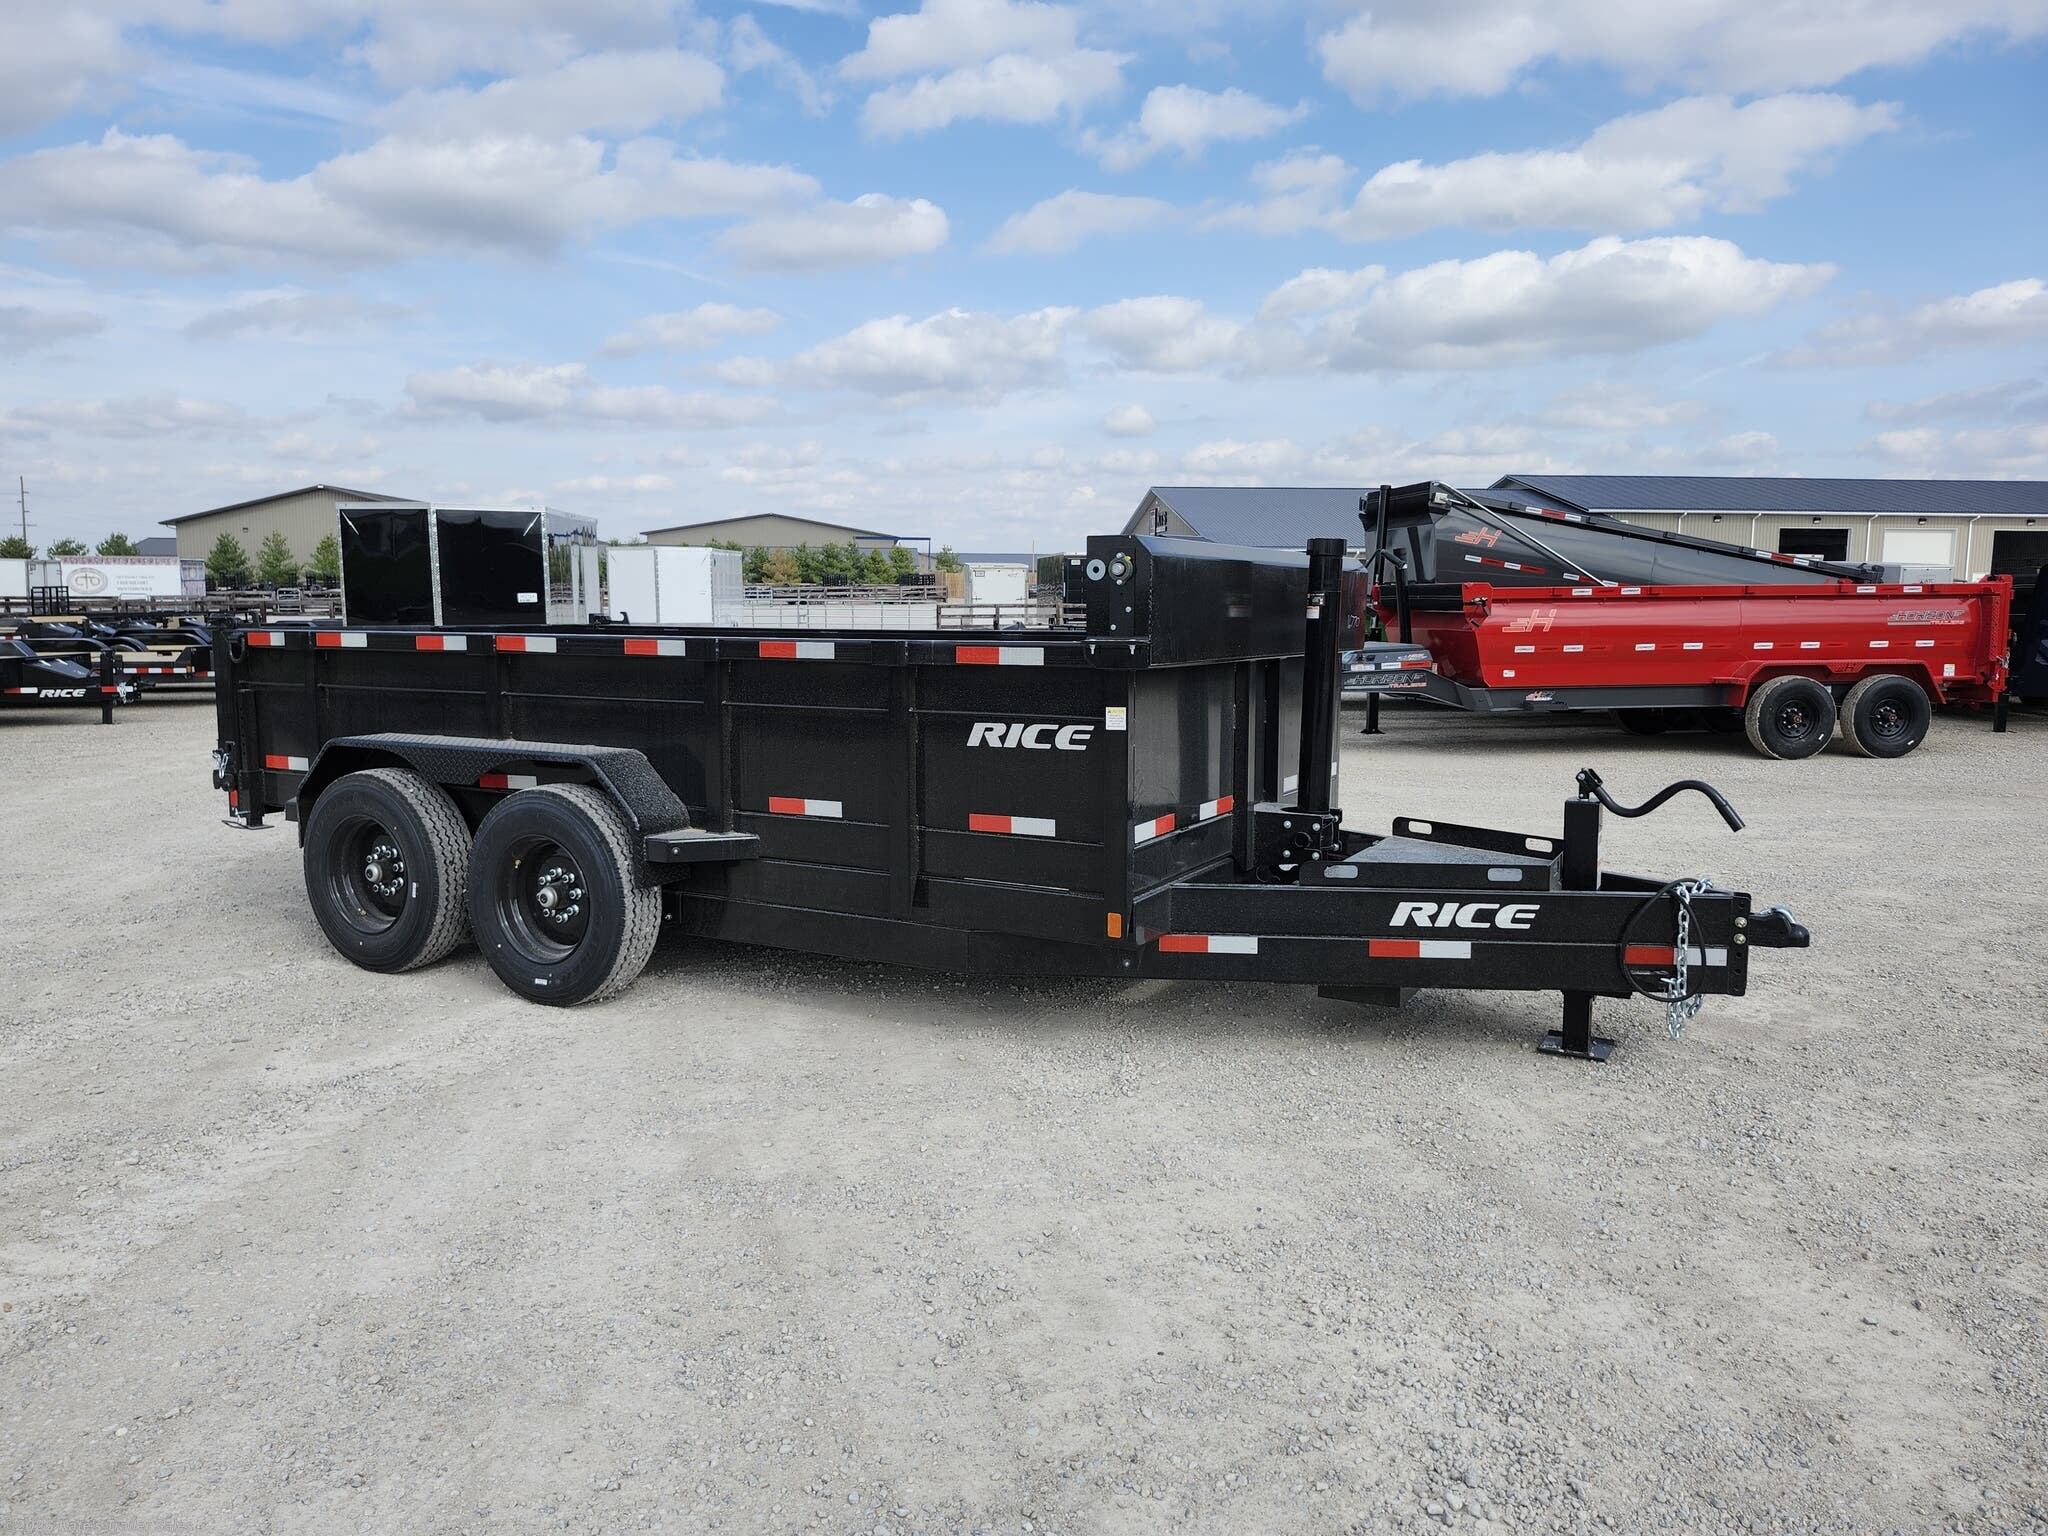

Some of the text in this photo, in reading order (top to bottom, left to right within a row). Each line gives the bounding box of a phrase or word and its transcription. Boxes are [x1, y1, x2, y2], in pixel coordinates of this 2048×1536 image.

[1354, 673, 1415, 685] HORIZON
[39, 688, 87, 698] RICE
[966, 722, 1095, 751] RICE
[1389, 901, 1540, 930] RICE
